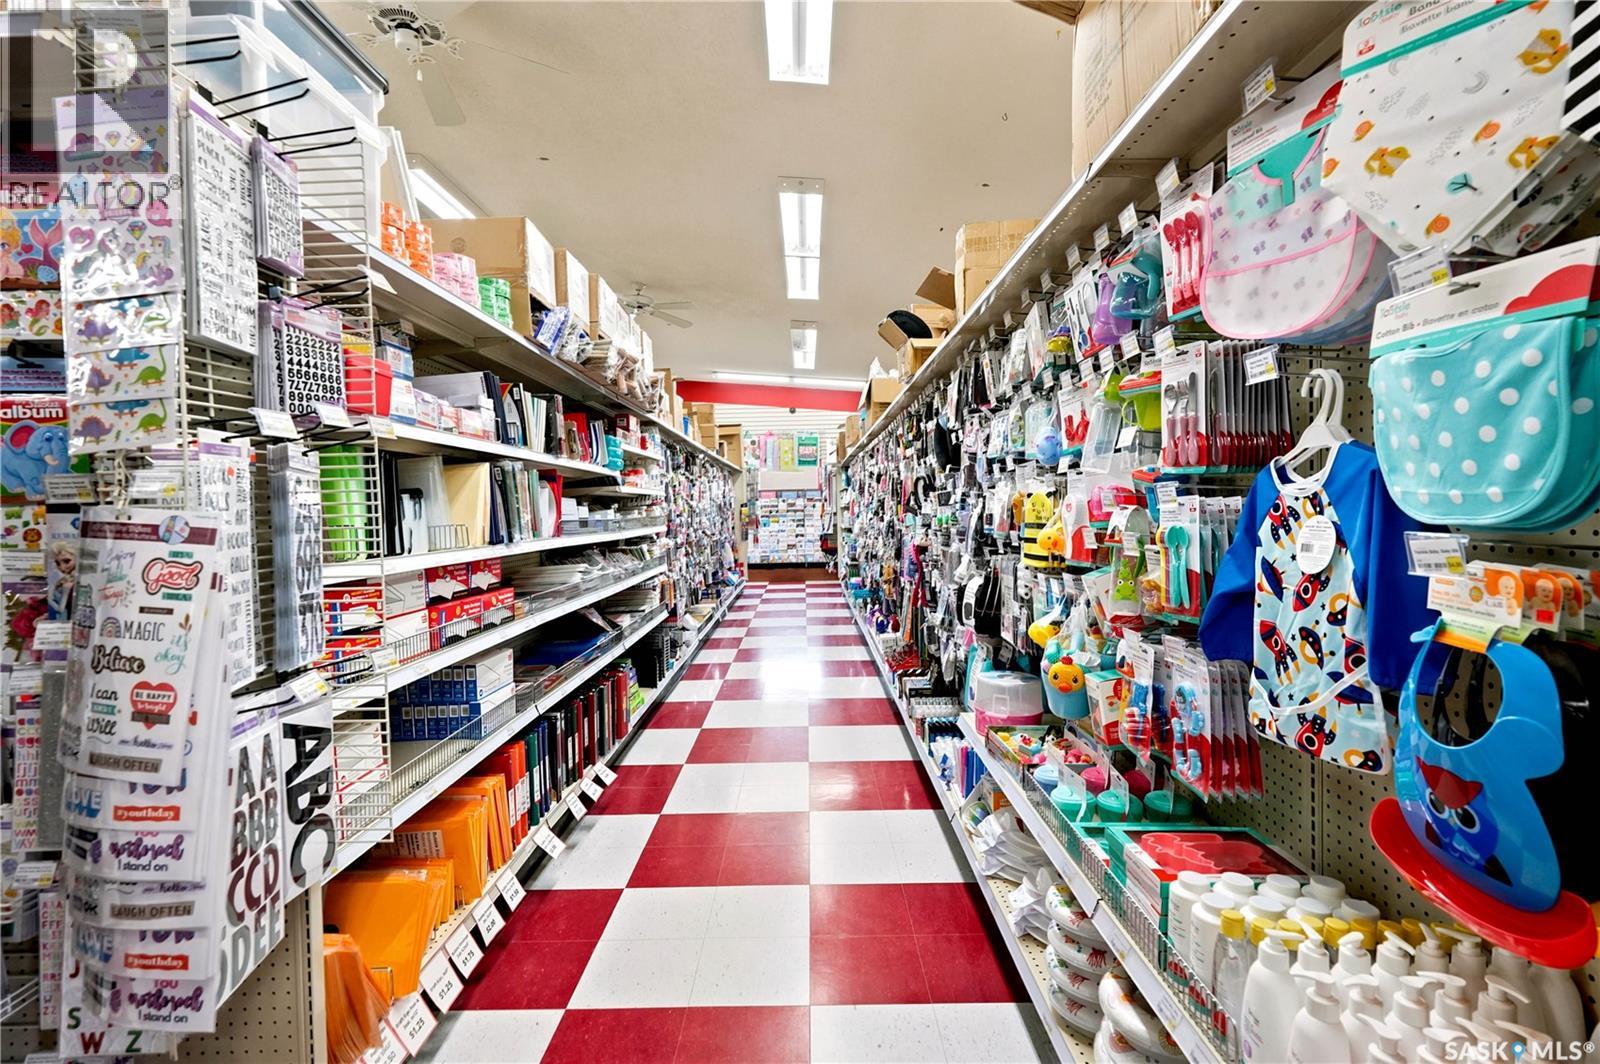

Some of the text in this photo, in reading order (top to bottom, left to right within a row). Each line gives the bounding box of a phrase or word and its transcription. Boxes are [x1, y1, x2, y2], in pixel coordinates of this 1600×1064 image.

[1375, 327, 1400, 339] Cotton
[1402, 321, 1415, 332] Bib
[0, 404, 64, 419] album
[143, 558, 203, 595] Good
[122, 620, 166, 643] MAGIC
[91, 645, 146, 674] Believe
[96, 688, 120, 702] can
[135, 691, 172, 701] BE HAPPY
[86, 716, 118, 737] will
[89, 752, 160, 773] LAUGH OFTEN
[122, 859, 152, 871] stand
[153, 863, 168, 871] on
[111, 902, 192, 918] LAUGH OFTEN
[127, 955, 184, 967] #youthday
[461, 949, 476, 967] $1.75
[438, 980, 454, 1000] $1.25
[67, 1007, 82, 1030] S
[142, 1010, 172, 1024] stand
[174, 1015, 189, 1024] on
[408, 1017, 426, 1040] $1.25
[81, 1032, 105, 1055] W
[125, 1030, 144, 1053] Z
